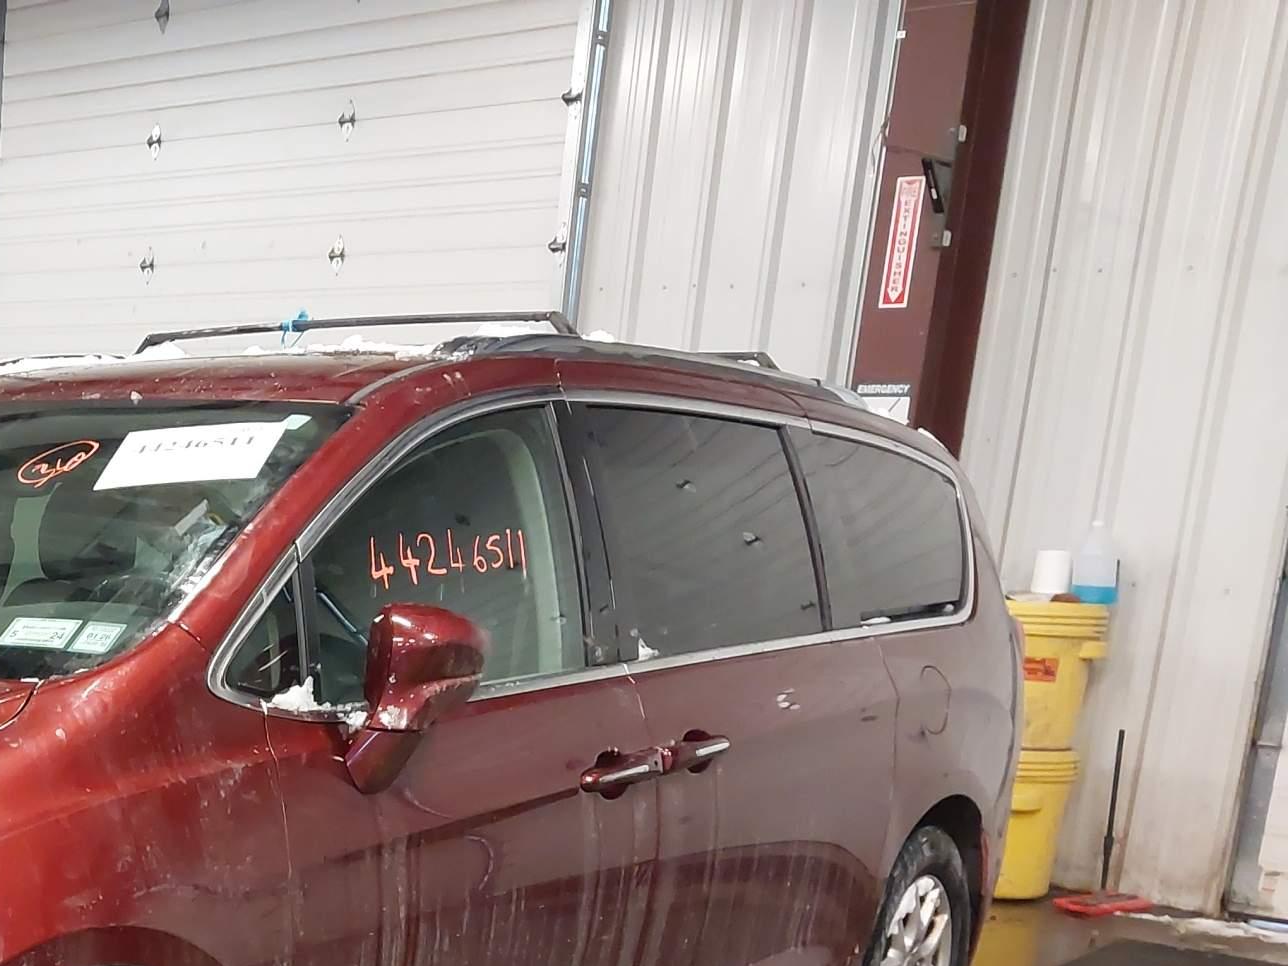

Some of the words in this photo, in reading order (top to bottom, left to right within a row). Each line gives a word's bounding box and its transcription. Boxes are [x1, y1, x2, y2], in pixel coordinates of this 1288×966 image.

[890, 201, 911, 292] EXTINGUISHER
[857, 384, 910, 394] EMERGENCY
[368, 528, 528, 590] 44246511
